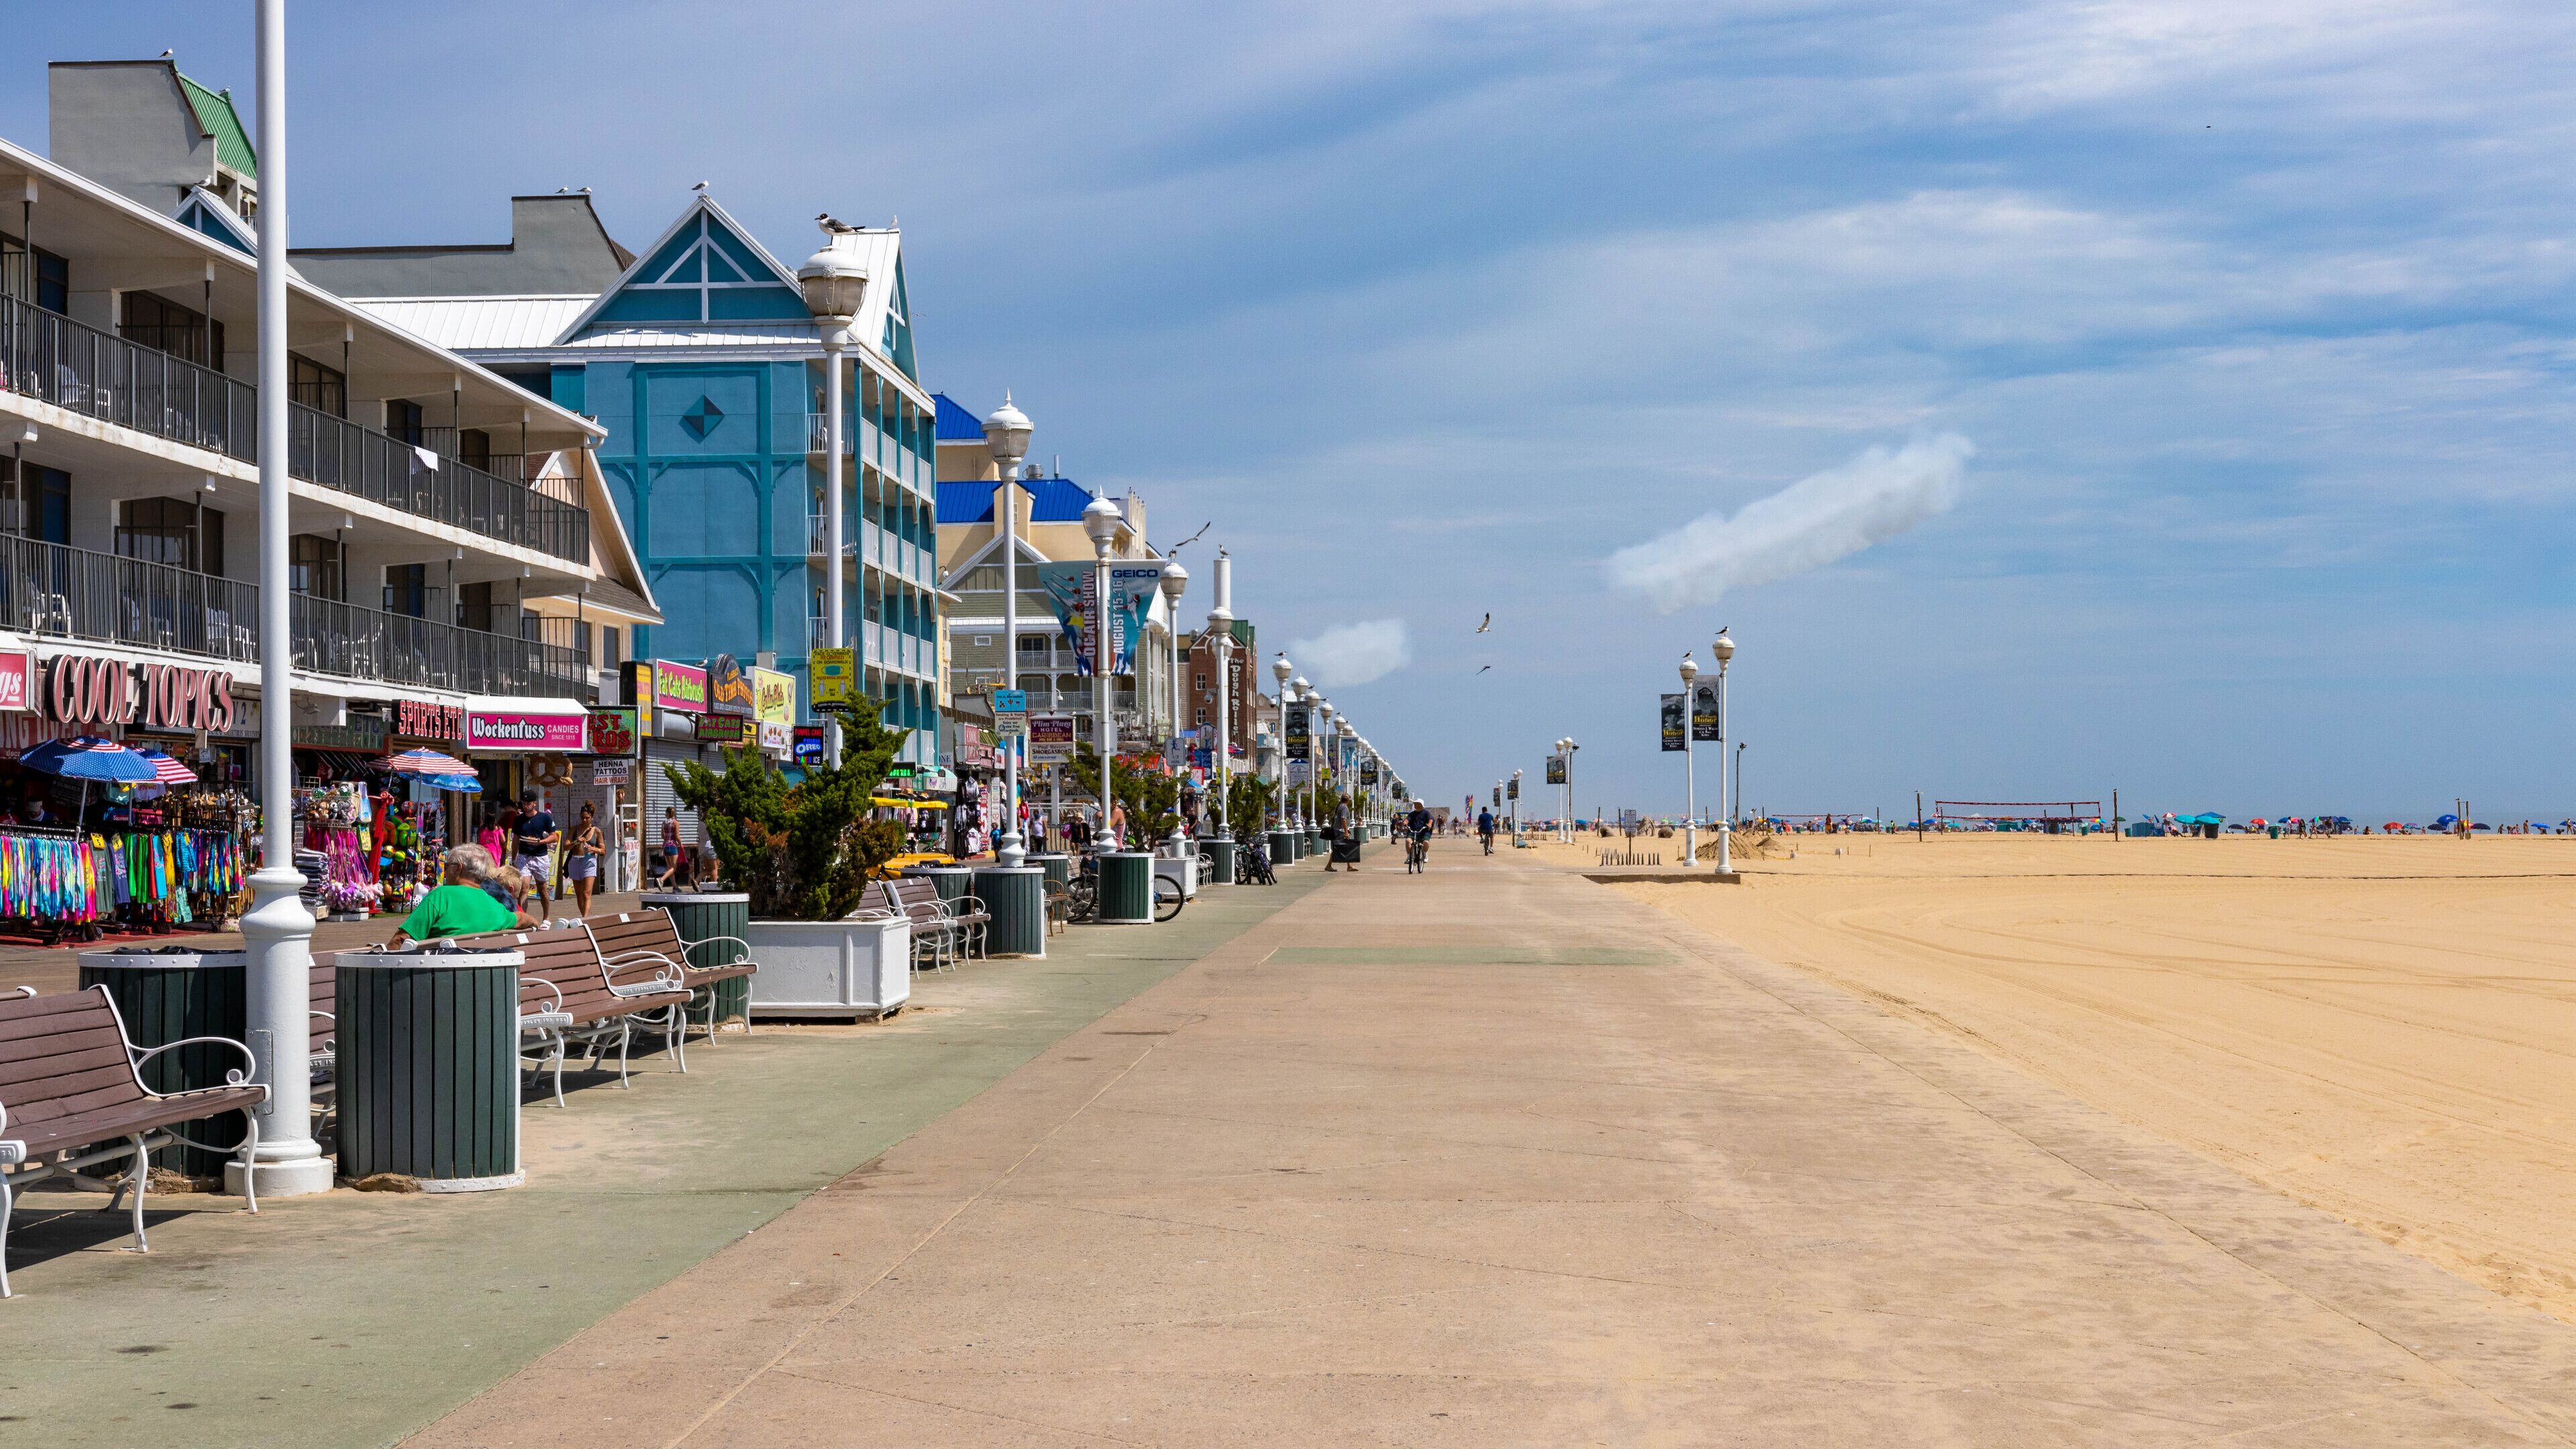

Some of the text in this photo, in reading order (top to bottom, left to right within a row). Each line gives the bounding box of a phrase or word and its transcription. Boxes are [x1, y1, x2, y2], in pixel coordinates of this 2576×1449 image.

[1112, 570, 1158, 578] GEICO
[1082, 571, 1095, 657] OC AIR SHOW
[1113, 580, 1124, 654] AUGUST 15-16
[54, 654, 233, 733] COOL TOPICS
[658, 667, 668, 696] Fat
[668, 671, 681, 698] Cats
[682, 675, 704, 704] Airbrush
[714, 678, 724, 703] OLD
[1230, 665, 1241, 736] Dough Roller
[398, 699, 465, 741] SPORTS ETC.
[471, 716, 580, 741] Wockenfuss CANDIES
[1051, 720, 1071, 729] Plaza
[1694, 715, 1717, 723] Honor
[796, 744, 820, 754] OREO
